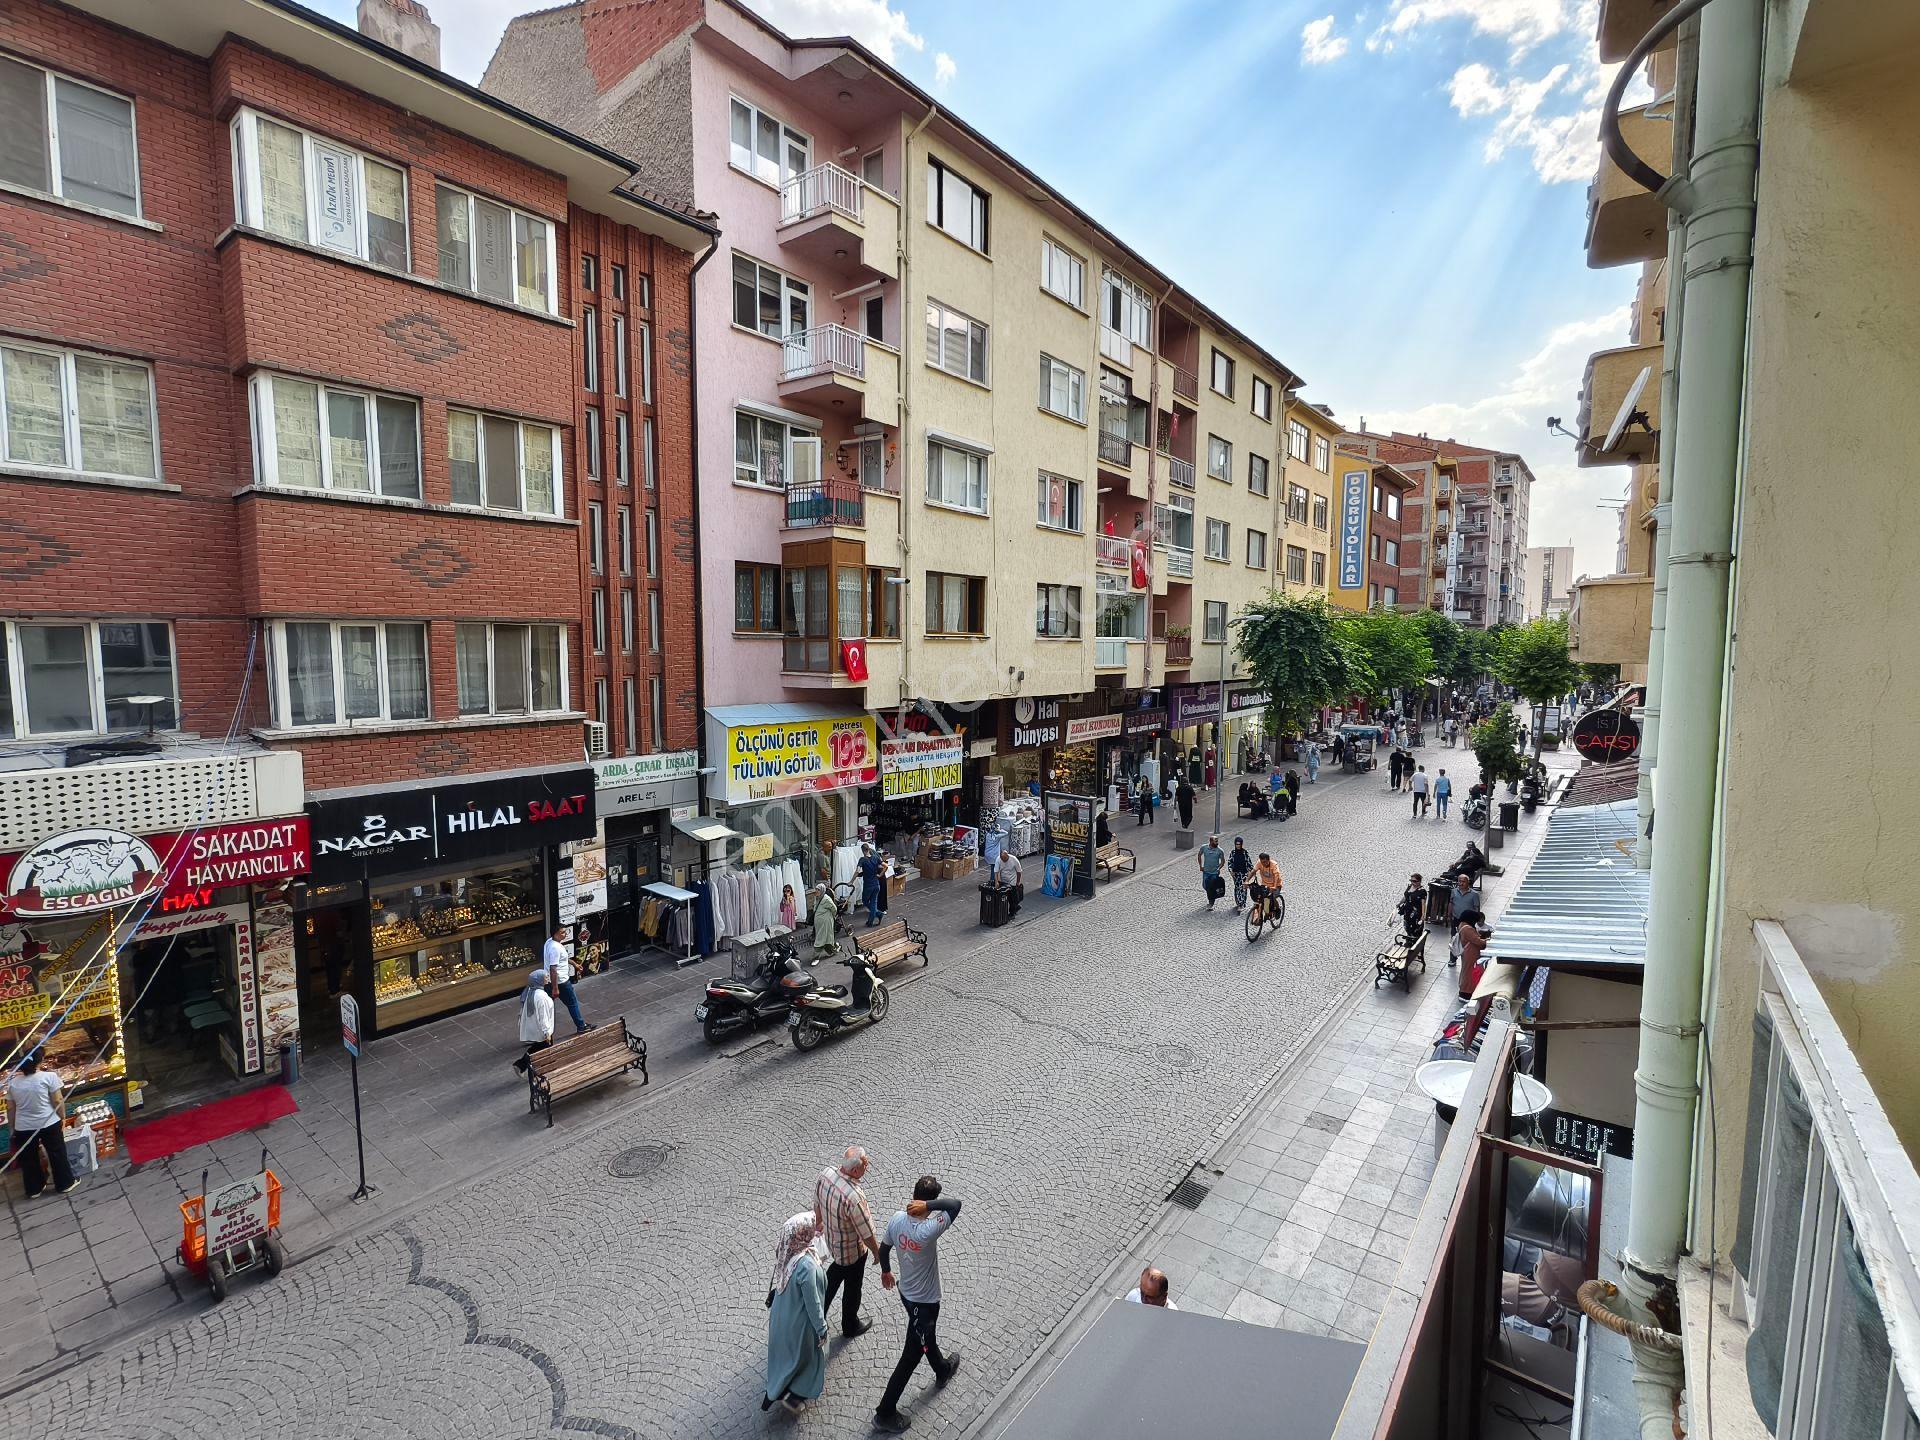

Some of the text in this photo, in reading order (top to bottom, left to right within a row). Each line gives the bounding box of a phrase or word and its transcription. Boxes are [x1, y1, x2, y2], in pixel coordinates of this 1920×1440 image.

[1038, 700, 1059, 720] Halı
[832, 720, 863, 730] Metresi
[1014, 725, 1059, 747] Dünyası
[736, 726, 819, 755] ÖLÇÜNÜ GETİR
[828, 730, 868, 769] 199
[601, 763, 628, 777] ARDA
[634, 760, 662, 776] ÇINAR
[665, 756, 696, 771] İNŞAAT
[733, 752, 821, 780] TÜLÜNÜ GÖTÜR
[915, 754, 934, 763] KATTA
[883, 762, 961, 797] ETİKETİN YARISI
[528, 795, 587, 823] SAAT
[617, 793, 644, 805] AREL
[193, 824, 296, 860] SAKADAT
[317, 826, 432, 855] NACAR
[352, 849, 375, 858] Since
[163, 889, 212, 911] HAY
[238, 924, 251, 966] DANA
[240, 971, 254, 1013] KUZU
[215, 1219, 261, 1242] SAKADAT
